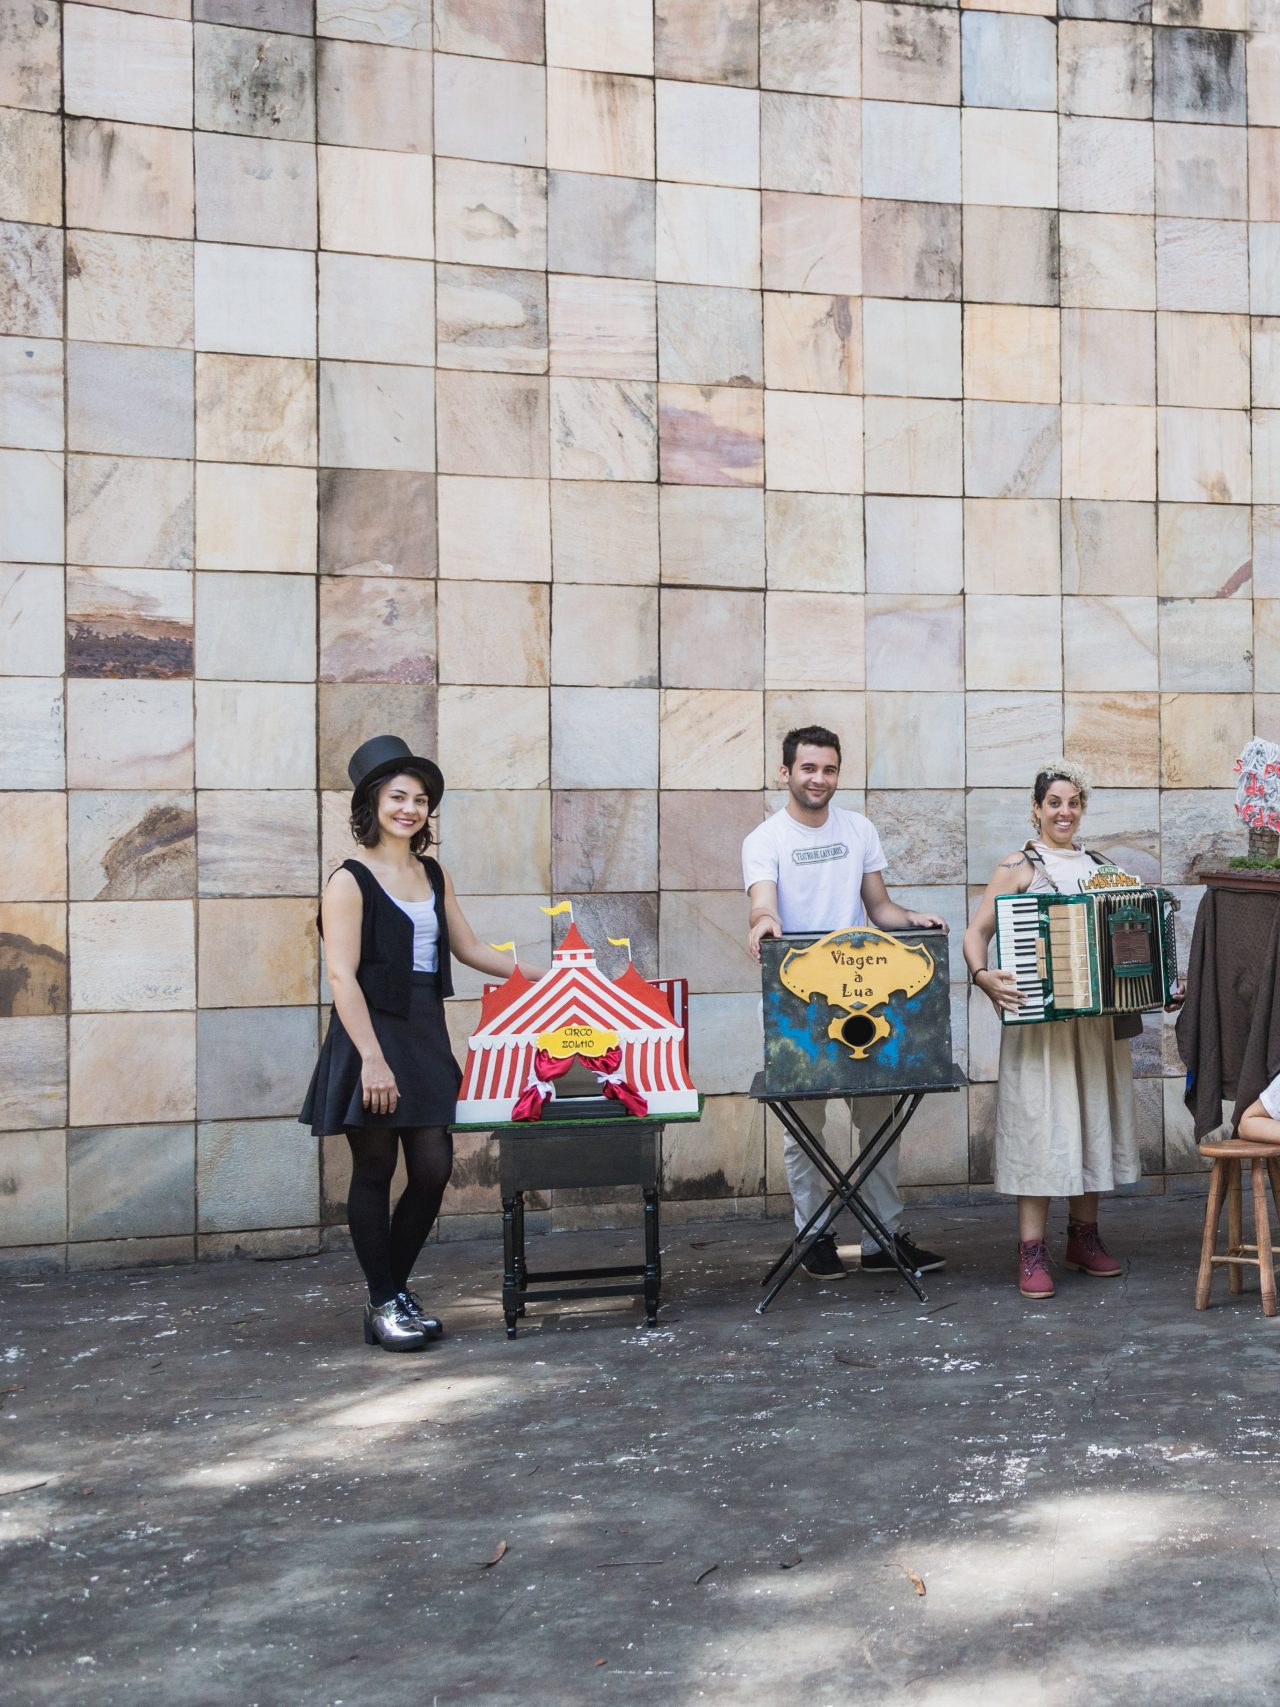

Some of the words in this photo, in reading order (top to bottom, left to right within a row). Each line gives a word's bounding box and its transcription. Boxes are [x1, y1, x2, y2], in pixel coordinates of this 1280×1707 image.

[831, 950, 887, 969] Viagem
[854, 971, 863, 982] à
[842, 983, 874, 997] Lua
[564, 1028, 593, 1037] CIRCO
[561, 1040, 595, 1049] ZOLHO
